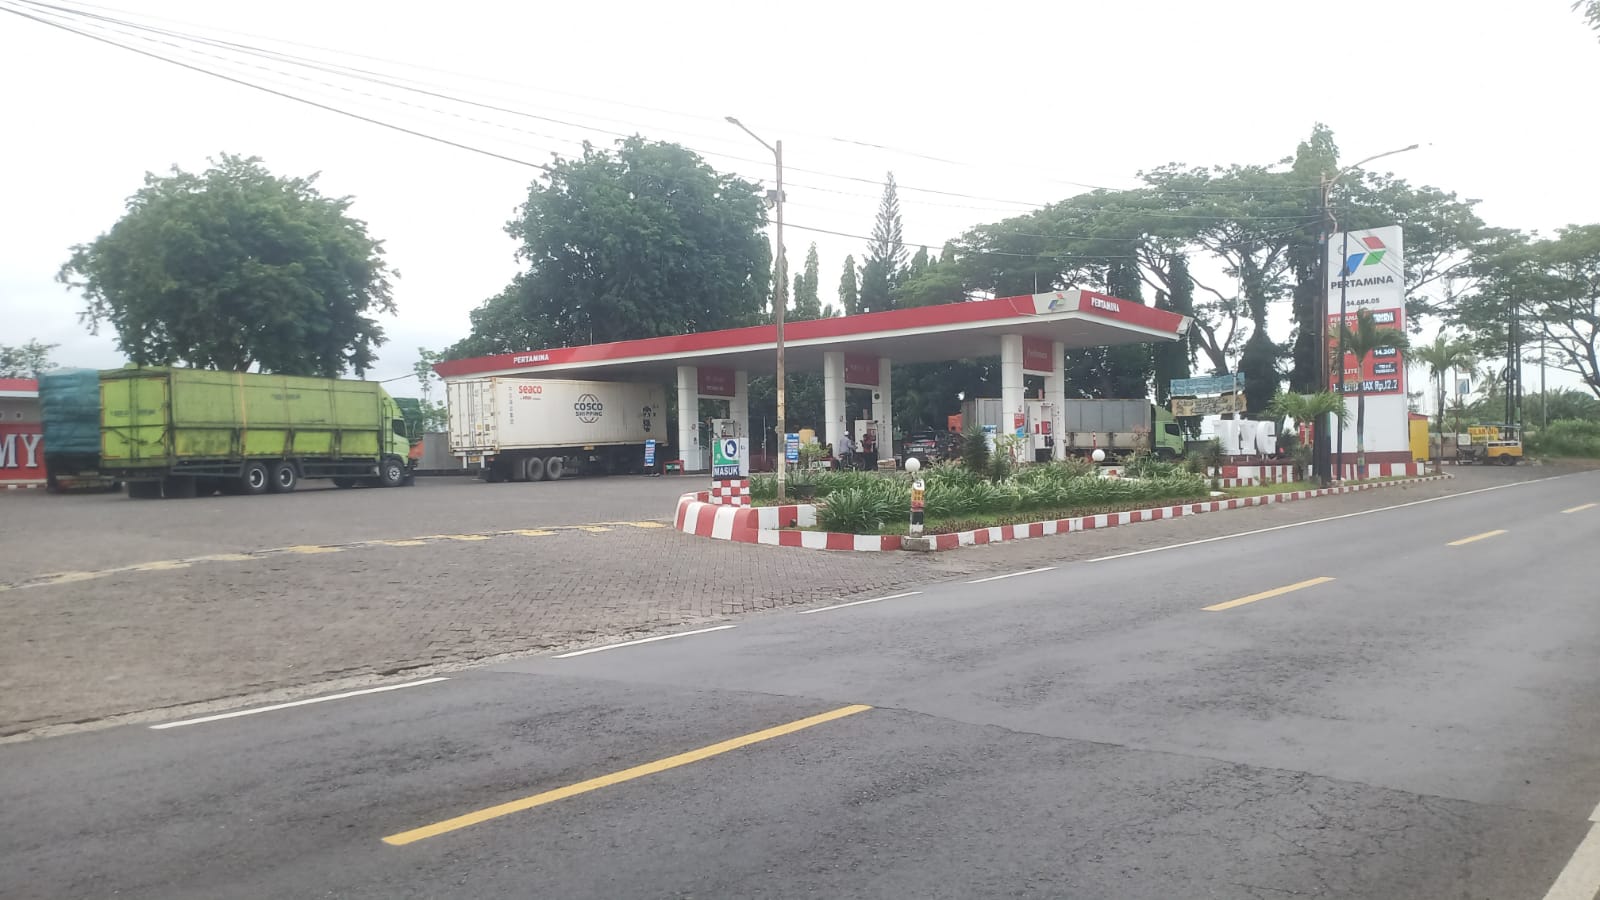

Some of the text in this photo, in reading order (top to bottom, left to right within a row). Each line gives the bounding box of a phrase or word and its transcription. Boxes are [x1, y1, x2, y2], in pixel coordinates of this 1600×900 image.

[1331, 276, 1393, 289] PERTAMINA
[1091, 297, 1120, 312] PERTAMINA
[513, 354, 549, 363] PERTAMINA
[518, 385, 542, 394] seaco
[574, 402, 603, 411] COSCO
[714, 466, 738, 476] MASUK
